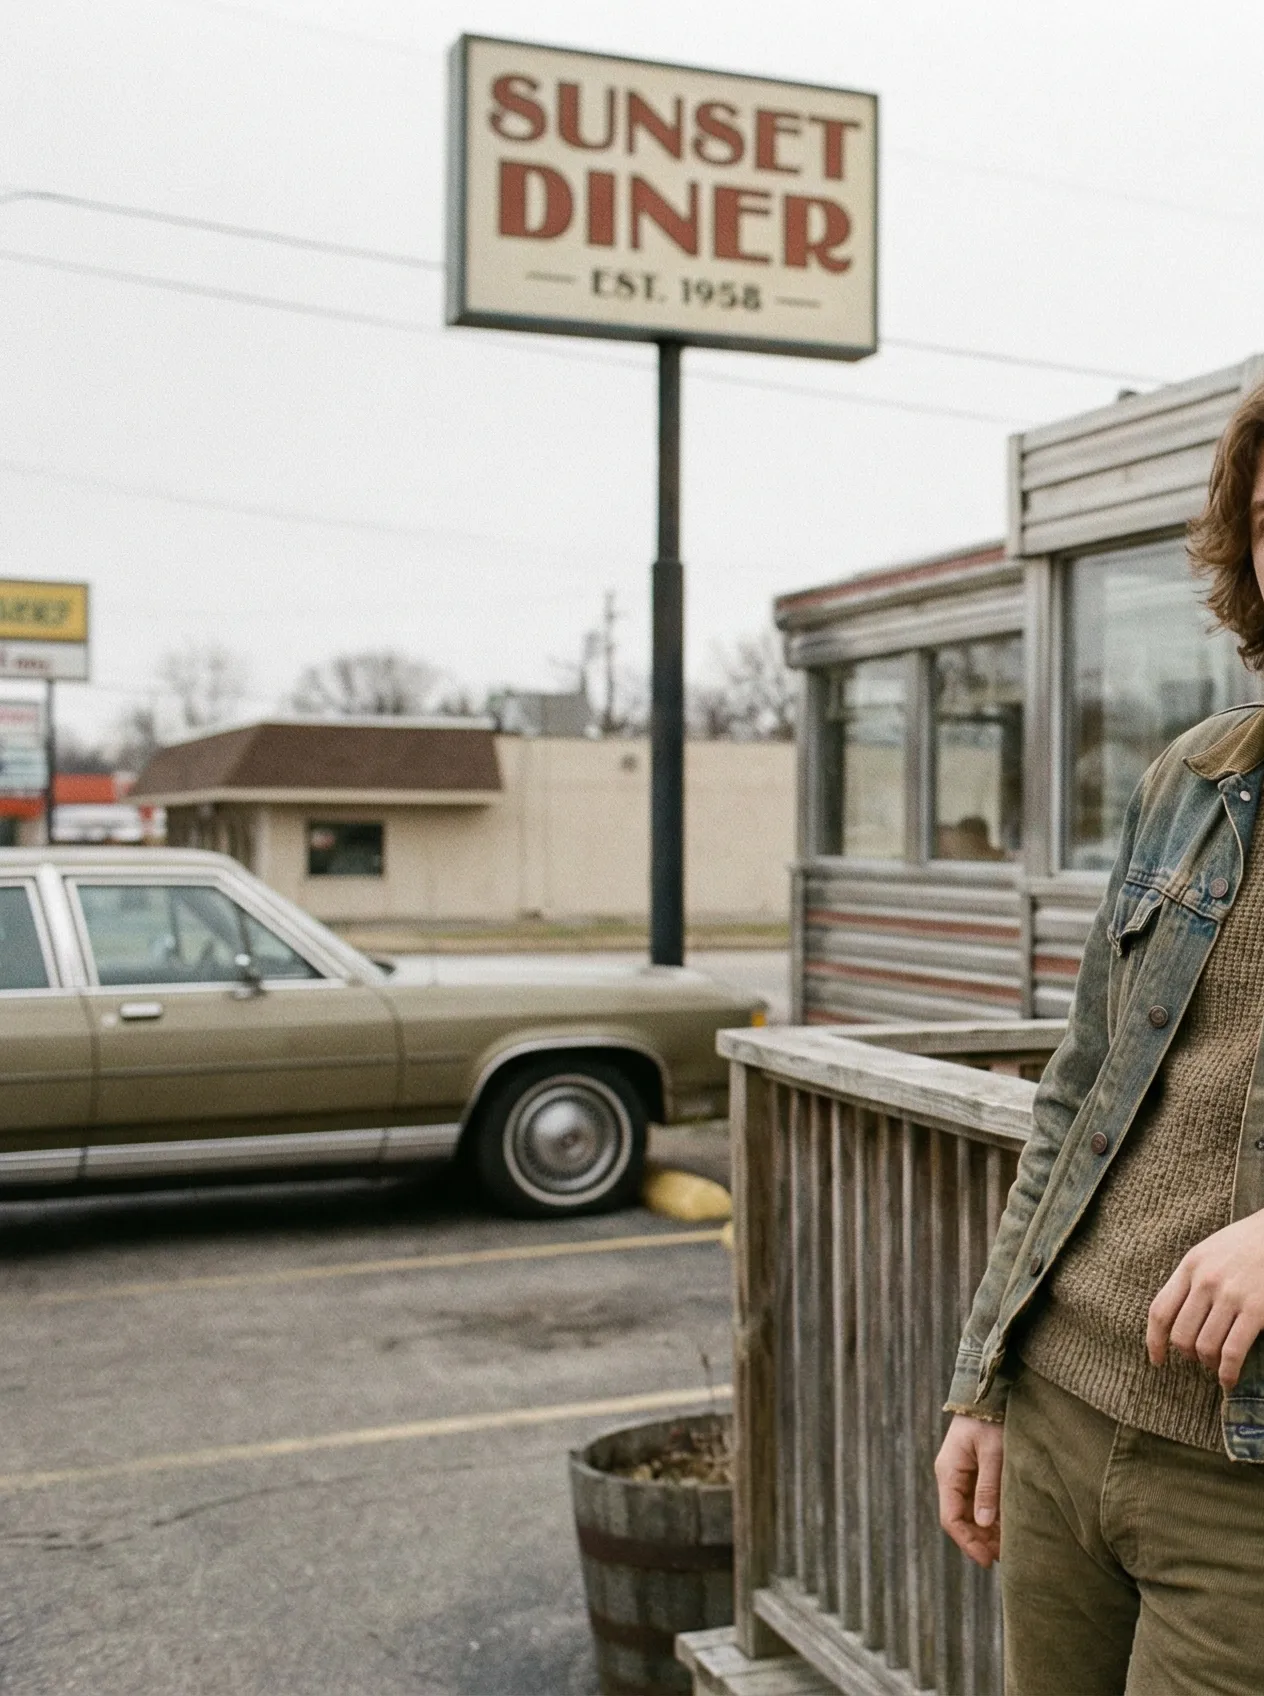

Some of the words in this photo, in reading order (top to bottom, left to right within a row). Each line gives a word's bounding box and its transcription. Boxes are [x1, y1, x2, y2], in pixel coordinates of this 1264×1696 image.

[489, 72, 862, 181] SUNSET
[497, 160, 853, 274] DINER
[590, 267, 667, 303] EST.
[681, 277, 763, 313] 1958
